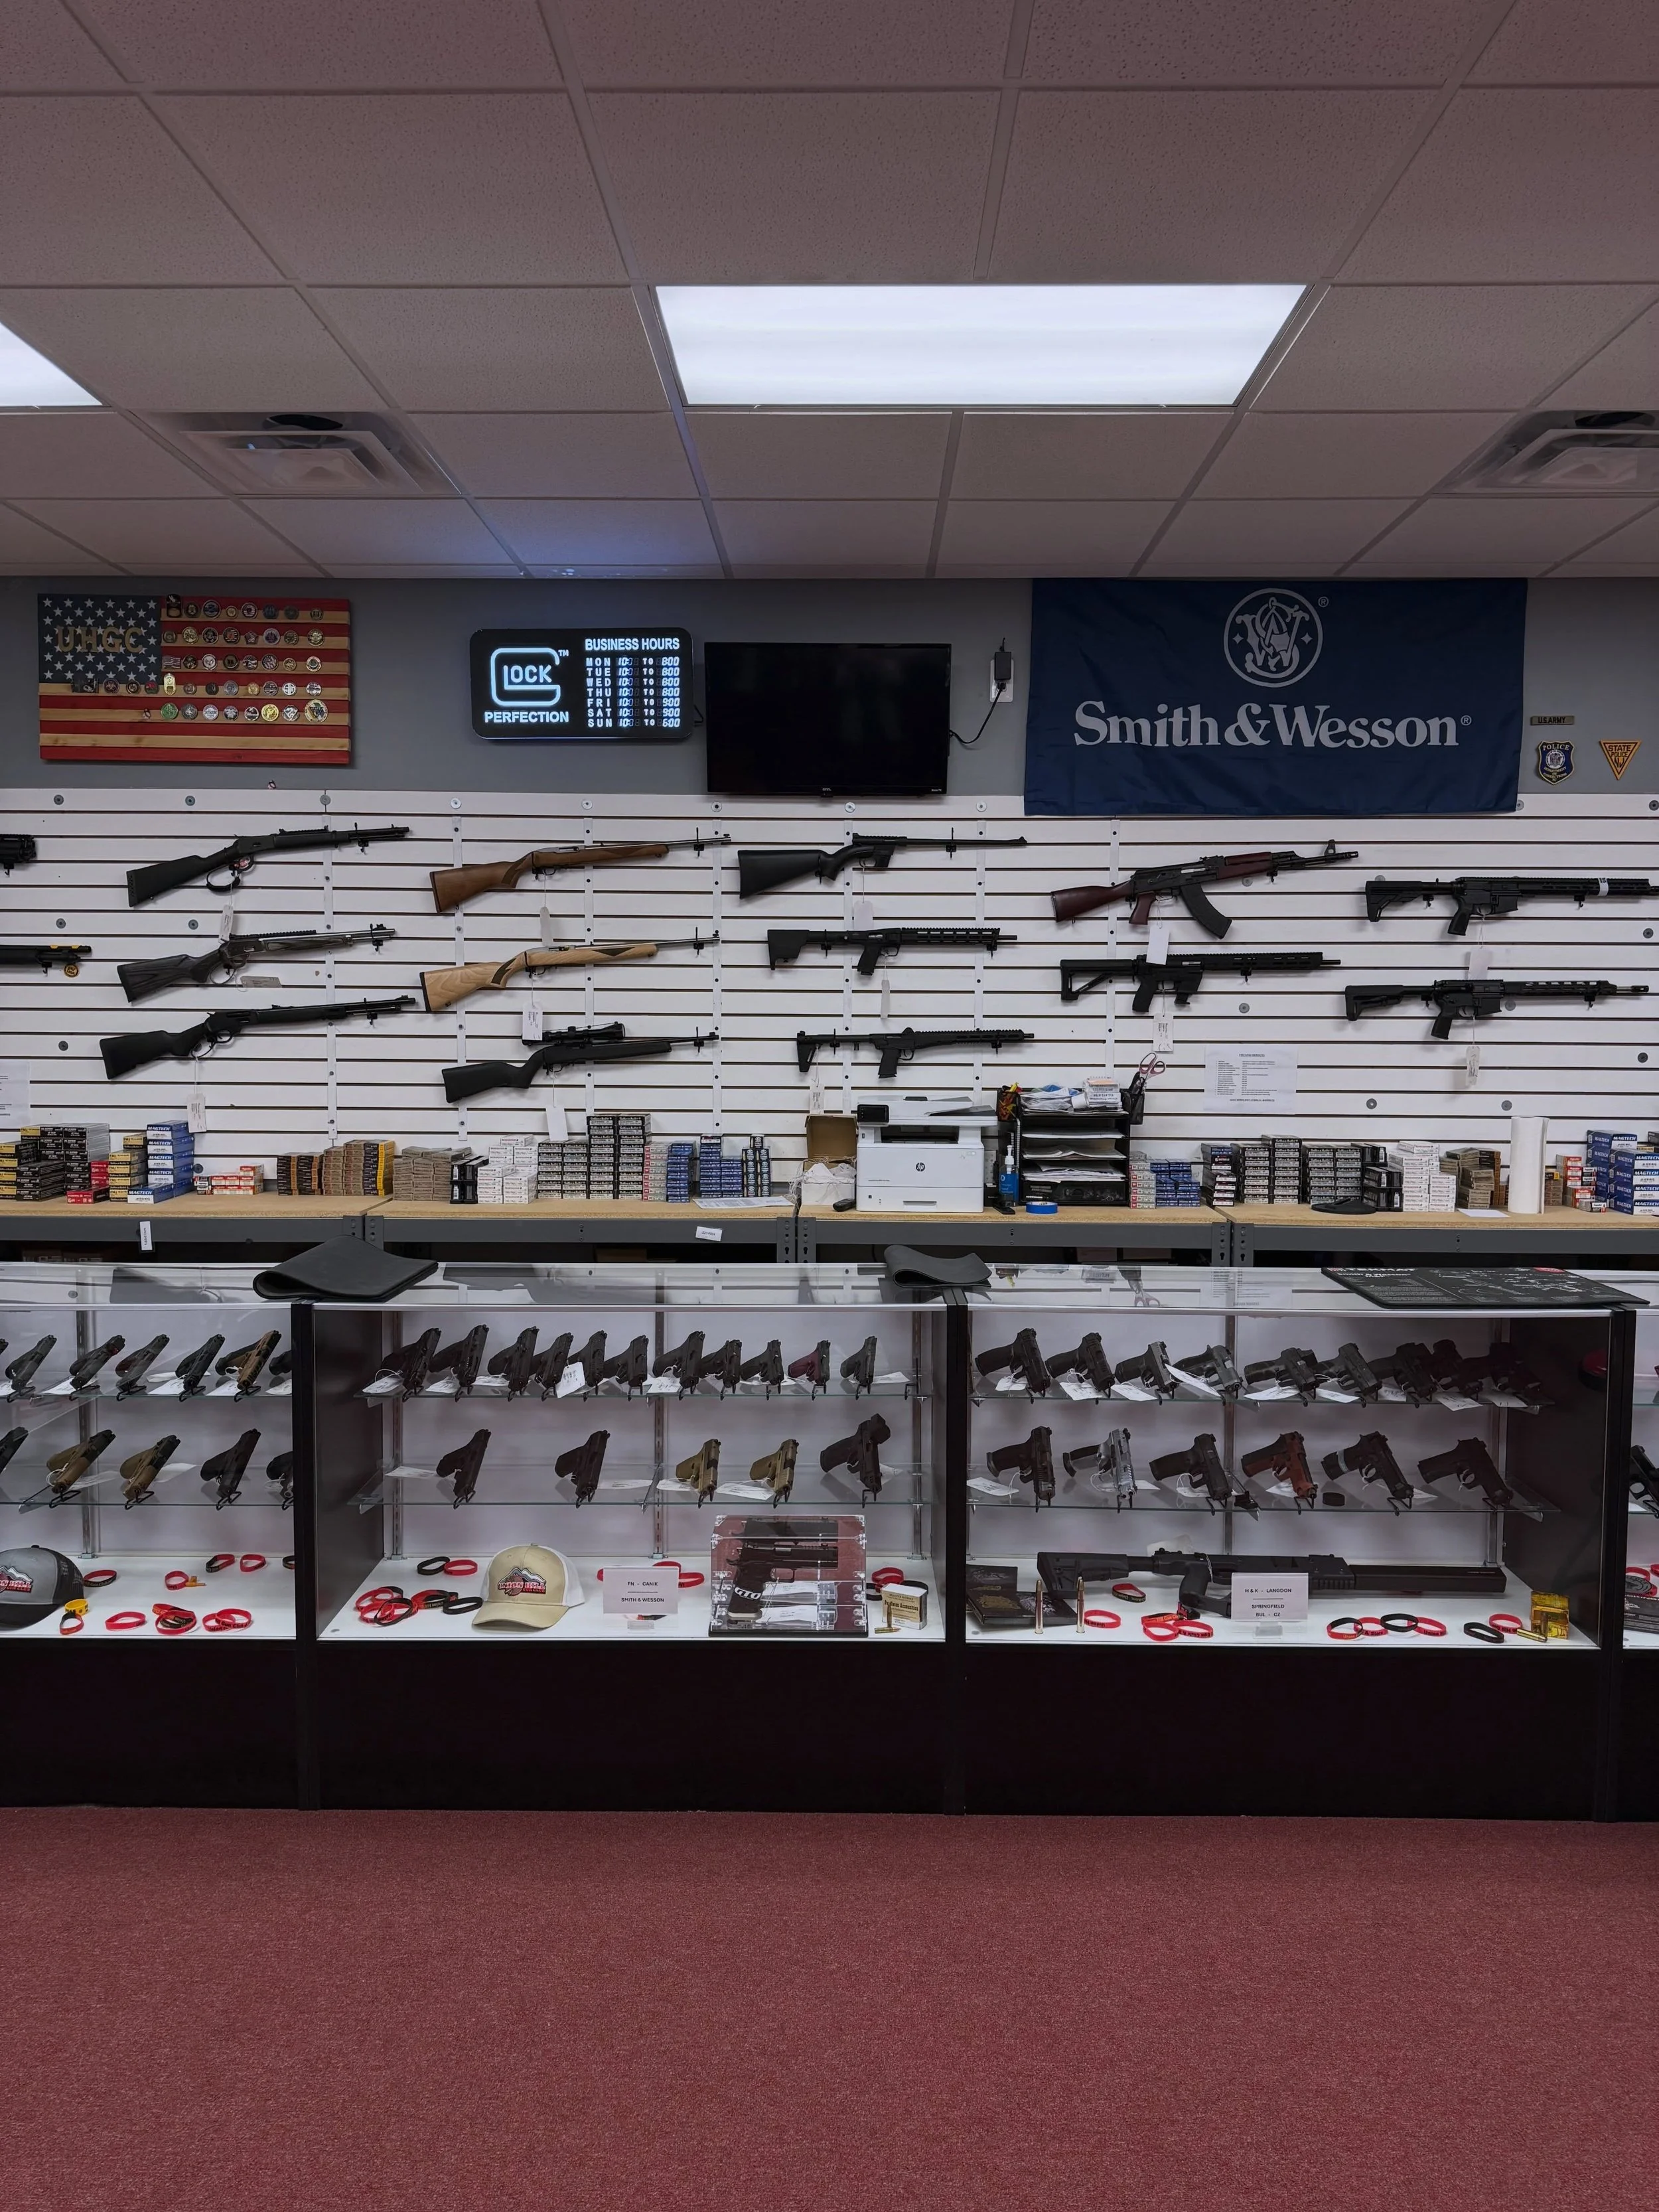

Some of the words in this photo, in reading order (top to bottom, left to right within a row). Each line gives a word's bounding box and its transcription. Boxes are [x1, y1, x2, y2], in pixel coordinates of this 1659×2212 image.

[57, 626, 143, 653] UHGC
[585, 638, 639, 650] BUSINESS
[642, 638, 680, 650] HOURS
[586, 657, 611, 666] MON
[587, 668, 611, 676] TUE
[587, 678, 611, 686] WED
[587, 688, 612, 697] THU
[587, 698, 611, 707] FRI
[484, 711, 569, 723] PERFECTION
[587, 708, 612, 717] SAT
[588, 719, 613, 727] SUN
